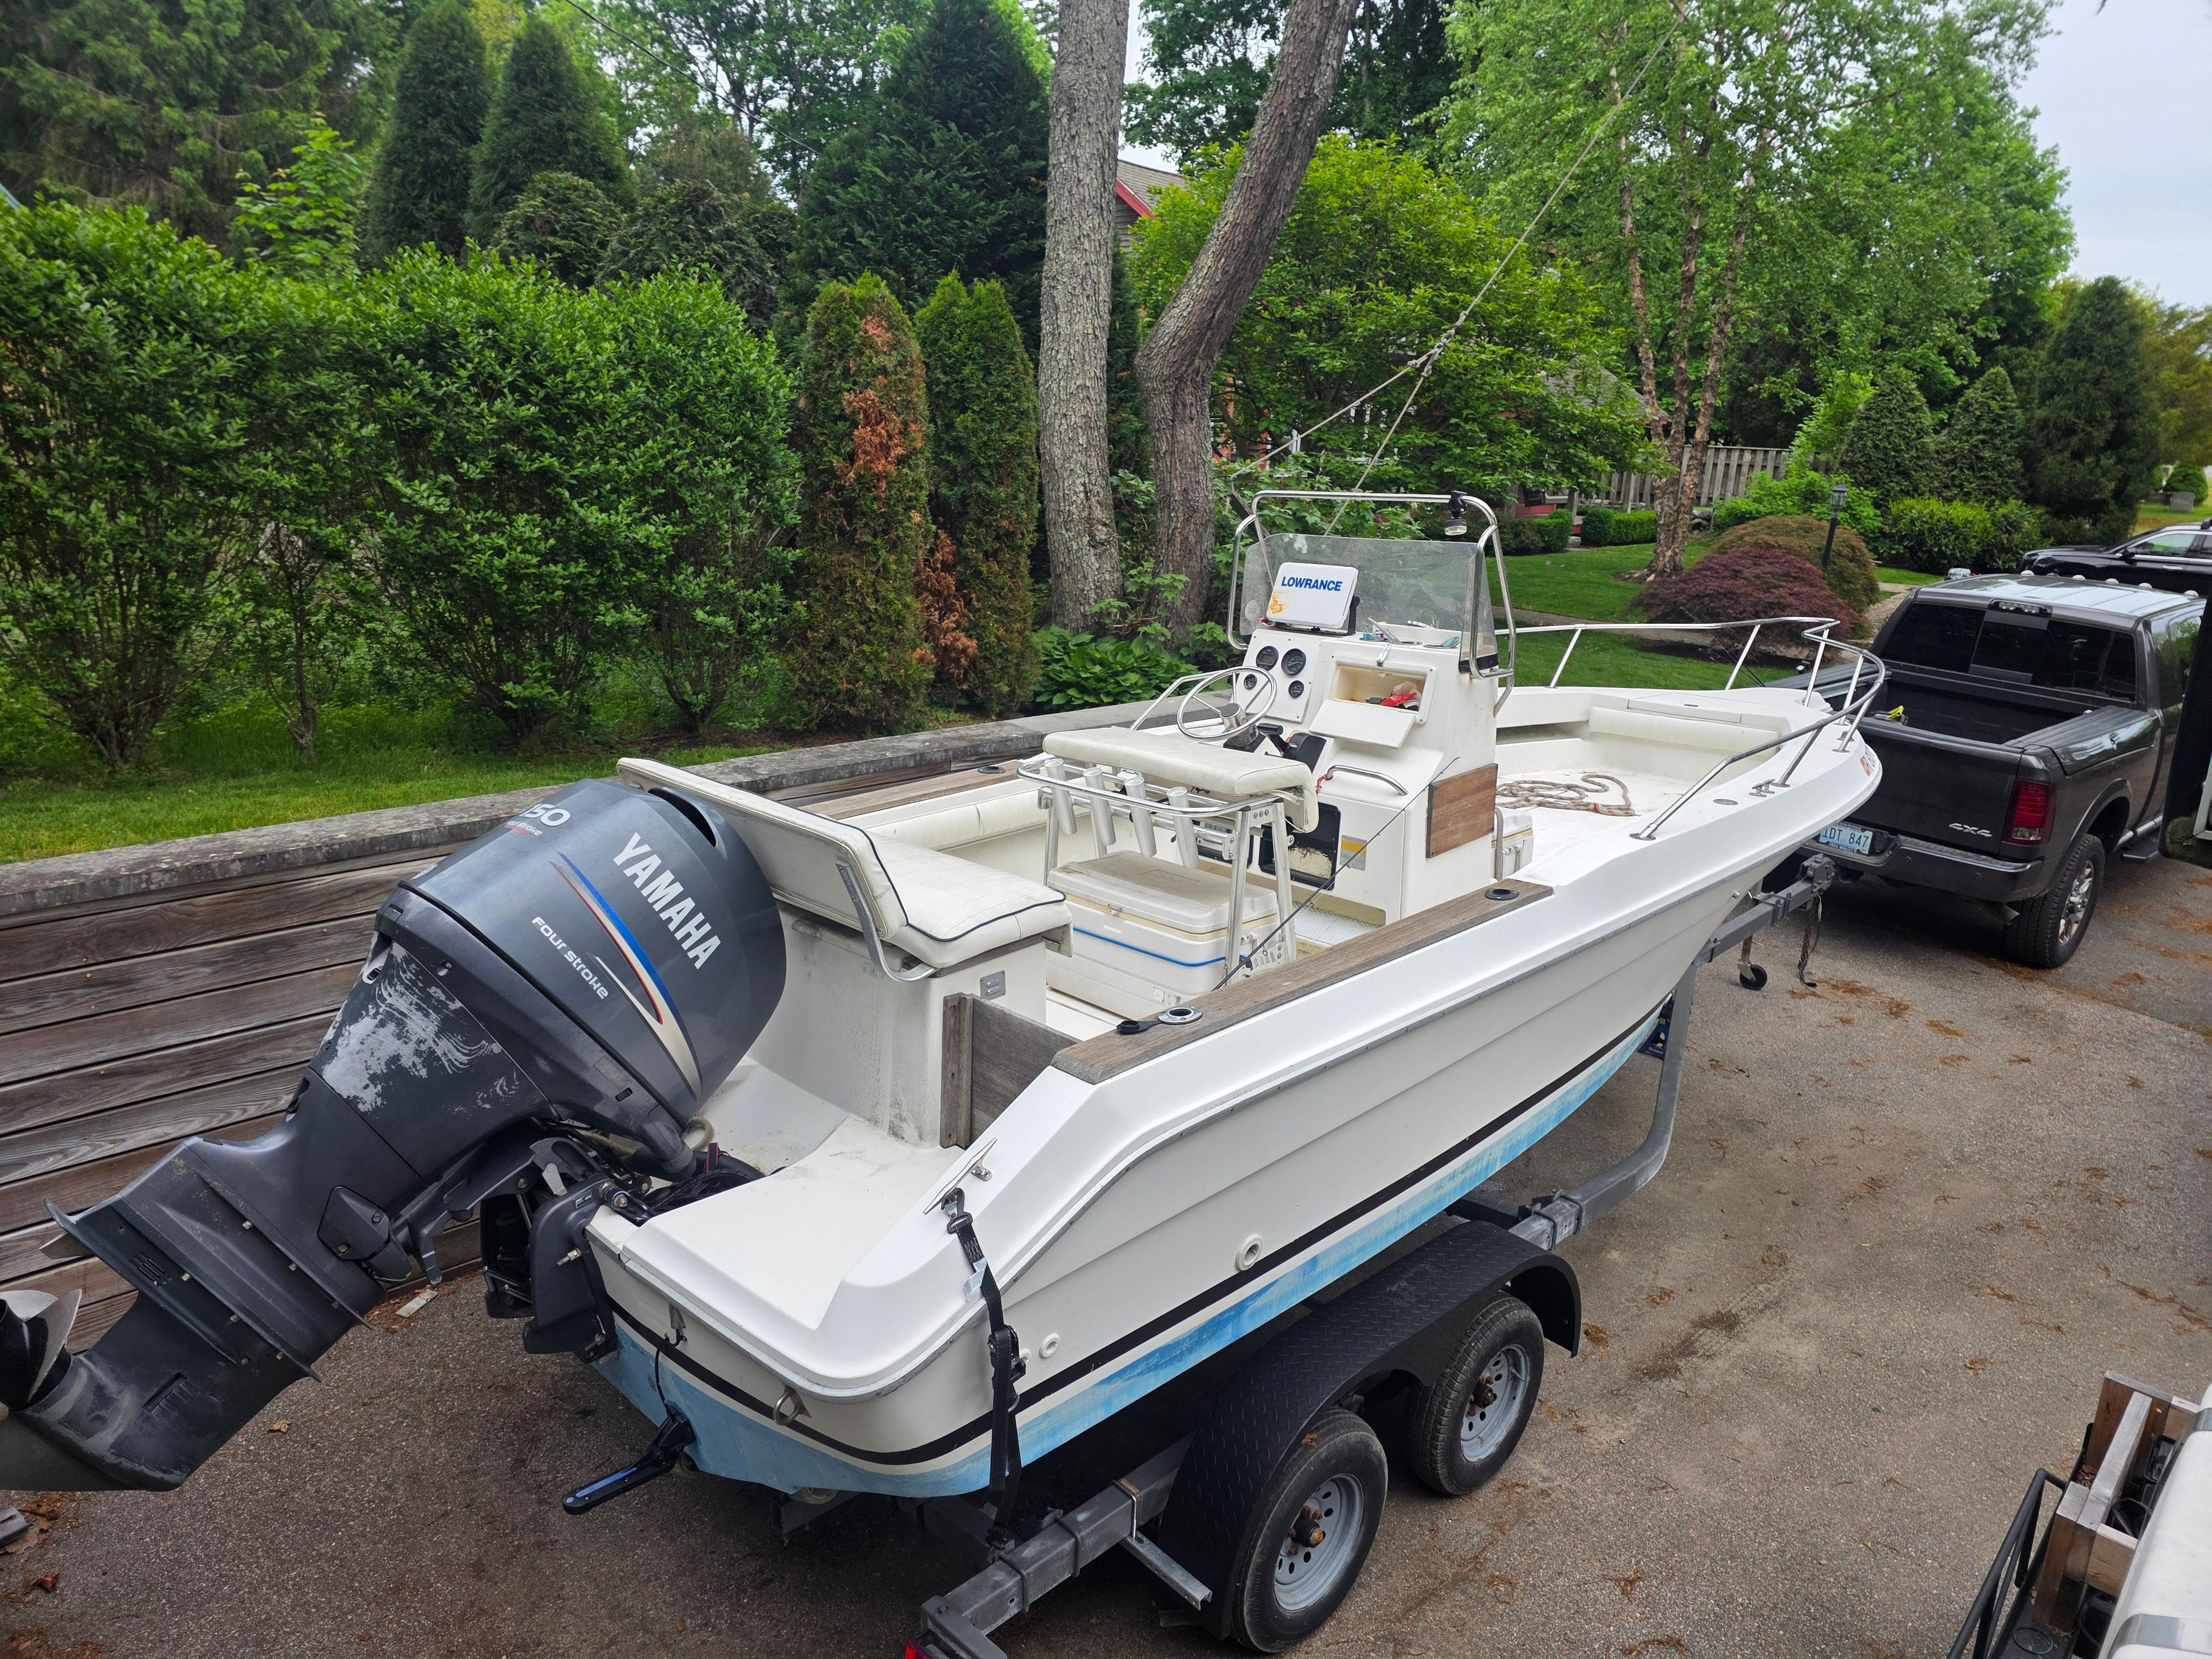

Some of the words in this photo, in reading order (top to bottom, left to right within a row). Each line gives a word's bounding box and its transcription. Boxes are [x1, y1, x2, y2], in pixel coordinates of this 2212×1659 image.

[1281, 576, 1343, 591] LOWRANCE
[1848, 832, 1869, 847] 847
[613, 832, 721, 970] YAMAHA
